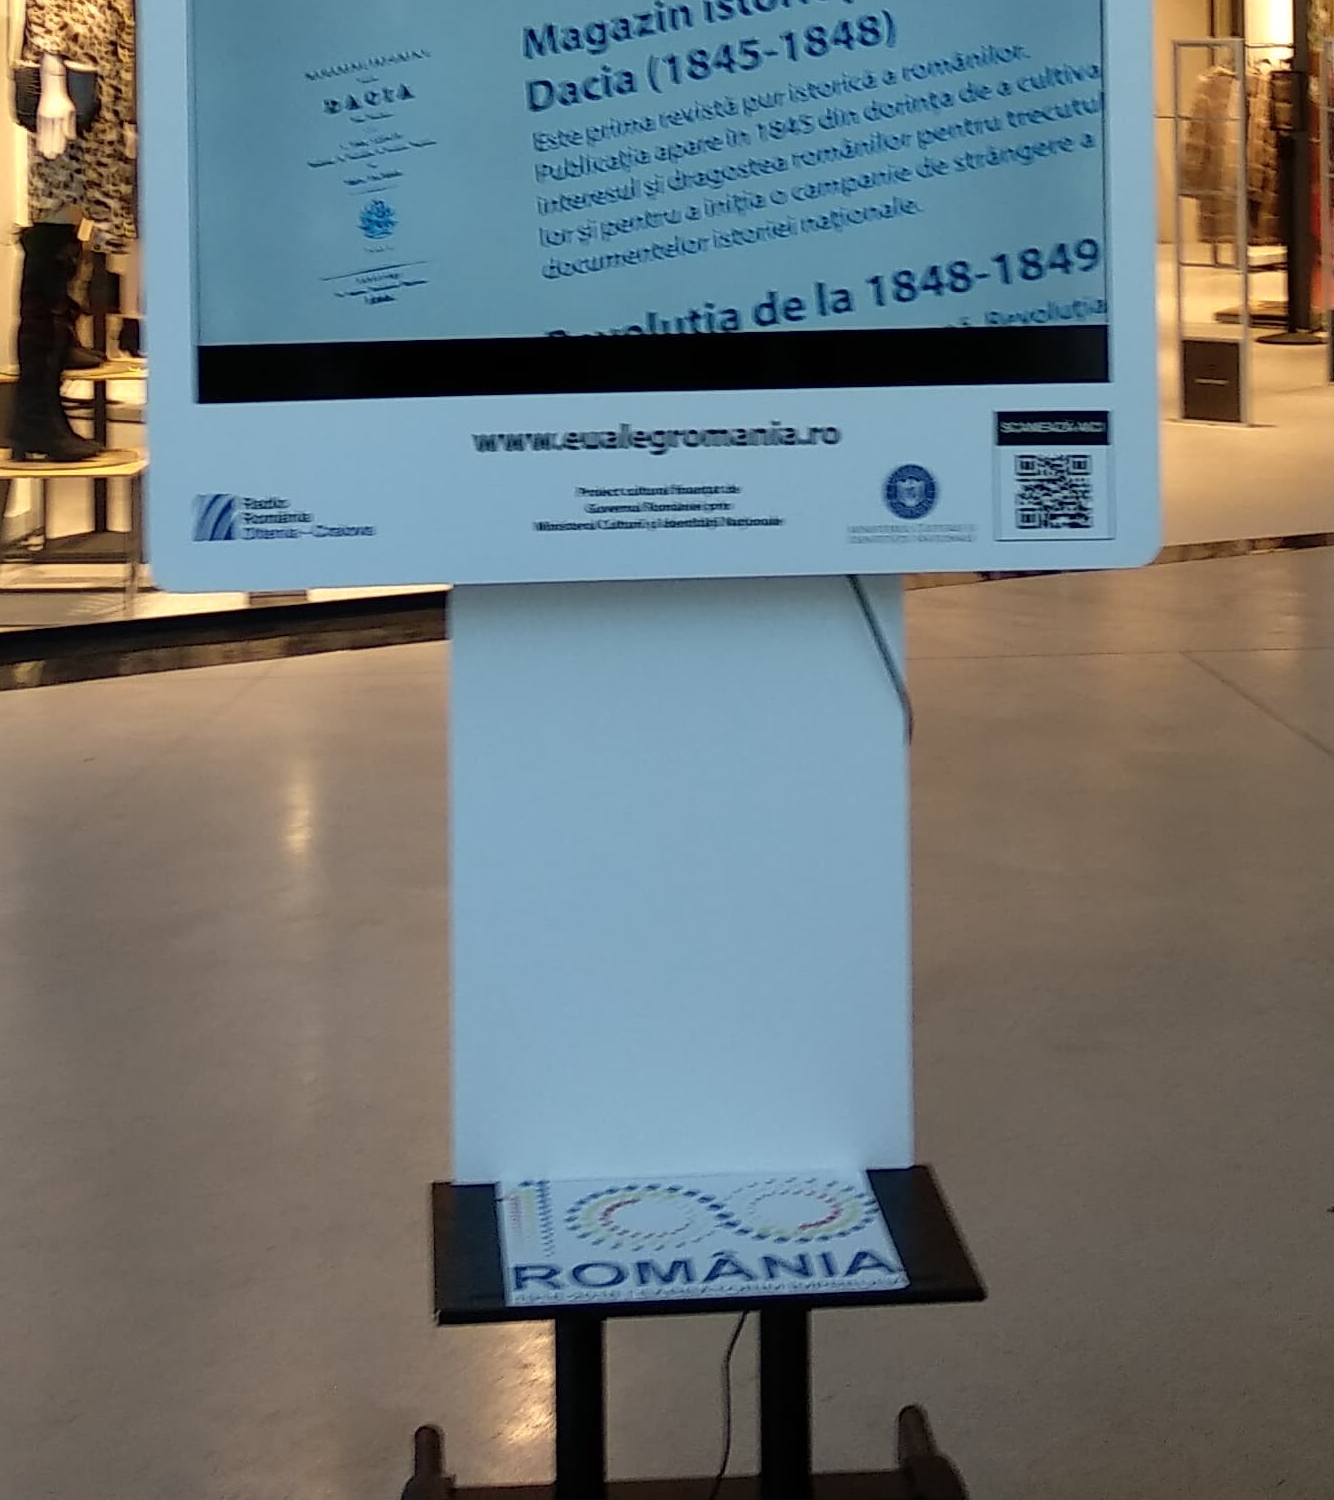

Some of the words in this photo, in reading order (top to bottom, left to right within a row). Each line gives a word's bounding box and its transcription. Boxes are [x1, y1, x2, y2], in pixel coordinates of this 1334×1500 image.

[522, 0, 695, 60] Magazin
[526, 64, 639, 112] Dacia
[647, 9, 897, 94] (1845-1848)
[752, 289, 807, 327] de
[814, 280, 855, 317] la
[866, 237, 1100, 308] 1848-1849
[470, 419, 842, 456] www.eualegromania.ro
[512, 1250, 895, 1292] ROMÂNIA
